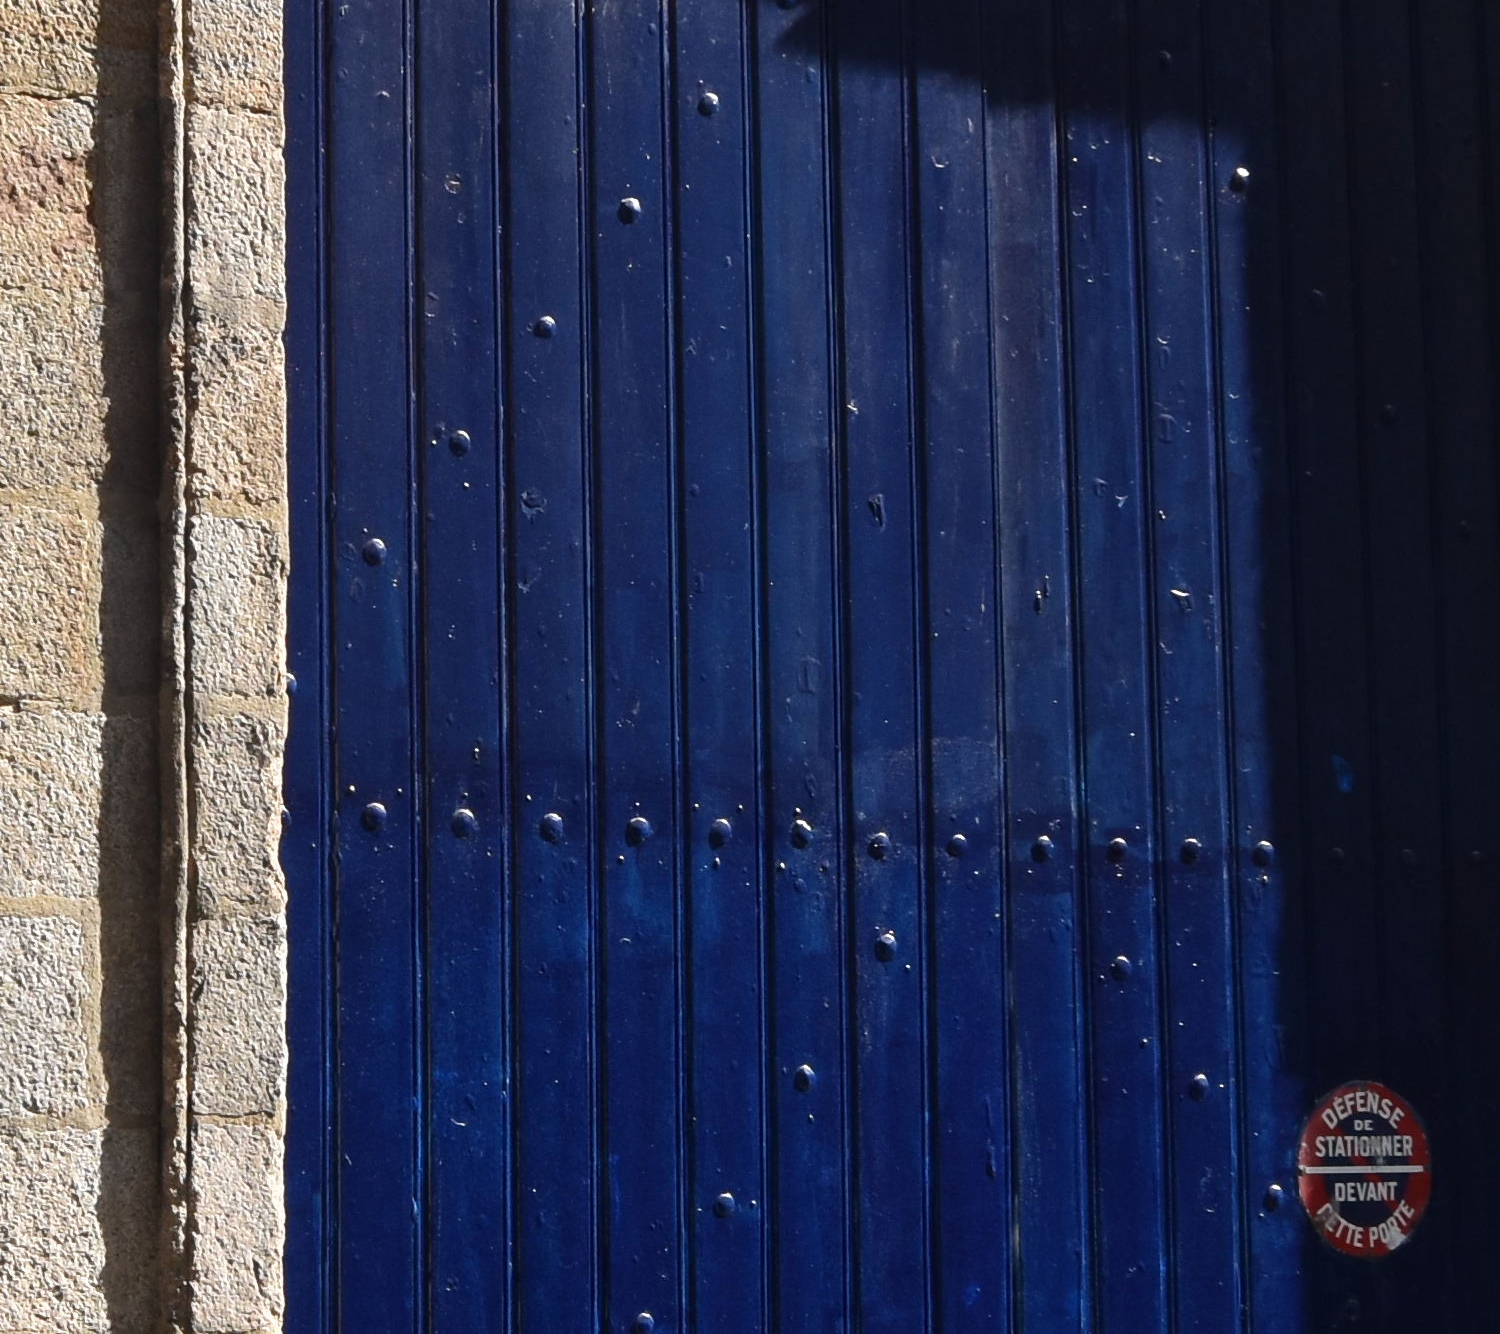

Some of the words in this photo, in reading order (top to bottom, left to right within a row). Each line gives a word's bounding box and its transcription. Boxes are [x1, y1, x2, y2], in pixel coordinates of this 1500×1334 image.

[1321, 1090, 1405, 1129] DÉFENSE
[1354, 1119, 1374, 1131] DE
[1315, 1135, 1413, 1157] STATIONNER
[1334, 1182, 1398, 1202] DEVANT
[1369, 1199, 1415, 1247] PORTE
